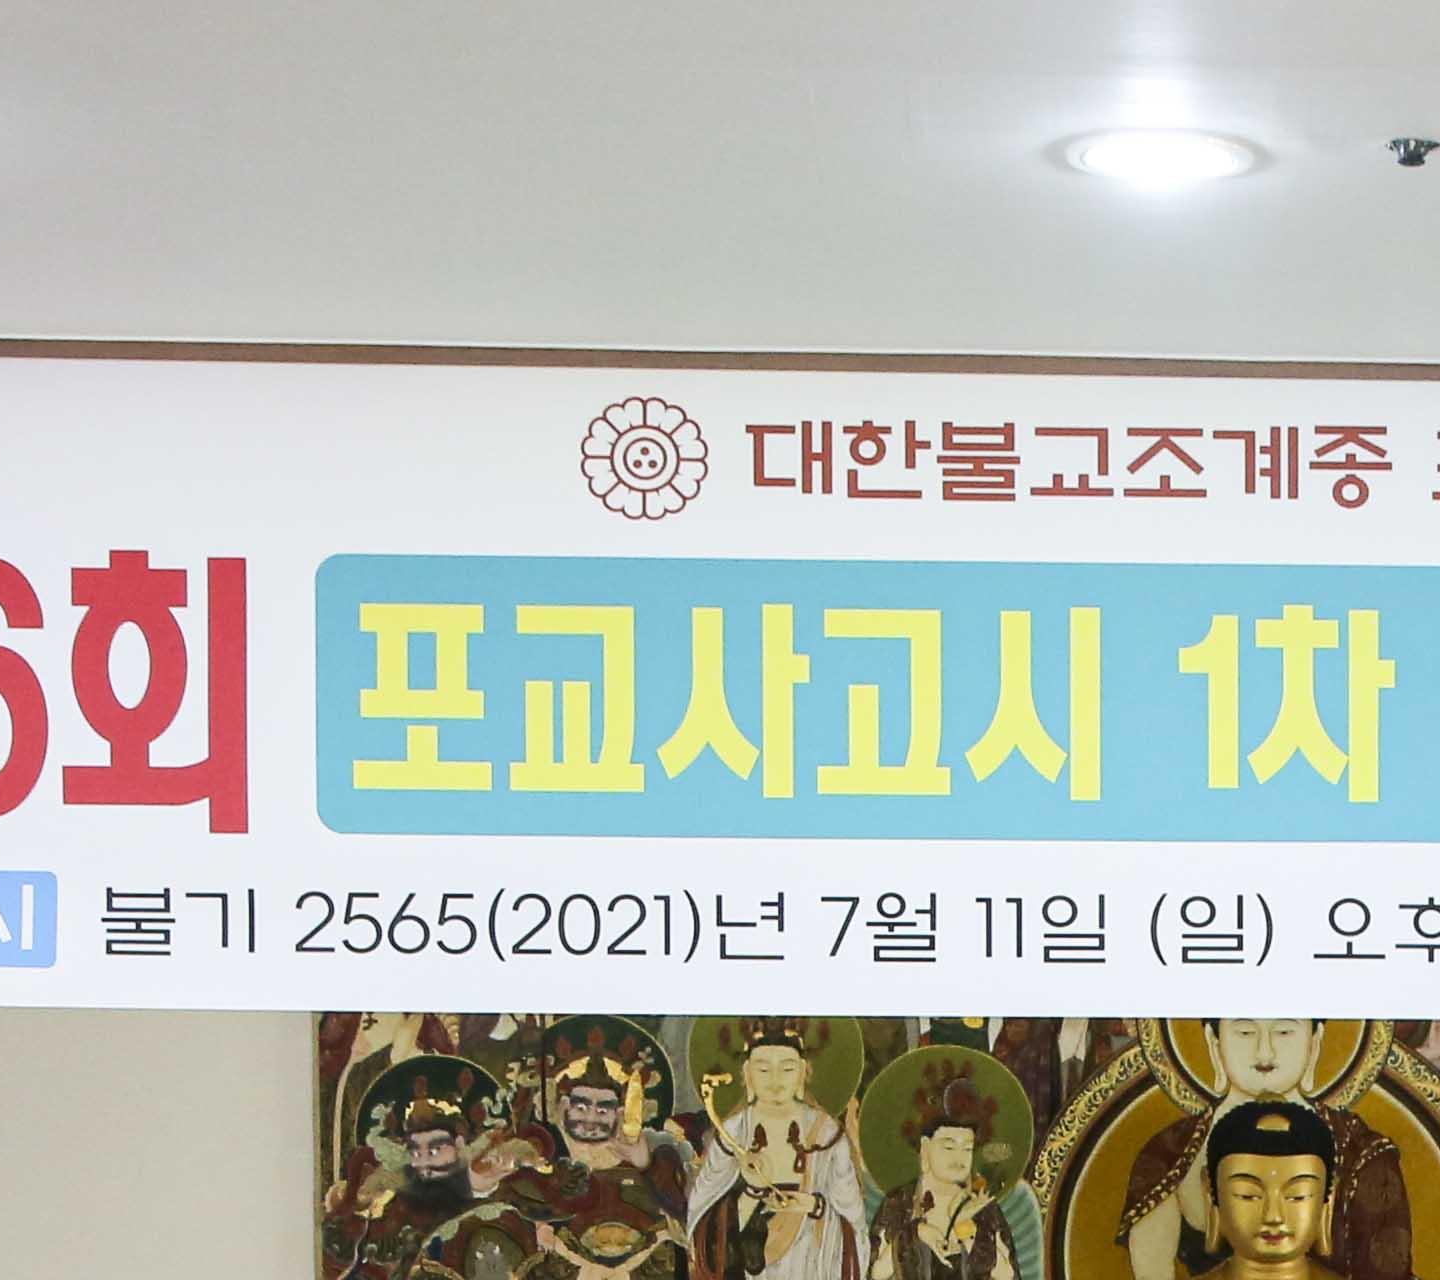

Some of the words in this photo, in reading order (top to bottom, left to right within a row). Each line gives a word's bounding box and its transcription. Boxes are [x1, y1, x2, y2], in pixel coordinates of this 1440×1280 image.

[745, 420, 1392, 509] 대한불교조계종
[354, 604, 1100, 800] 포교사고시
[1180, 605, 1394, 802] 1차
[101, 887, 255, 956] 불기
[296, 888, 784, 963] 2565(2021)년
[821, 892, 936, 962] 7월
[976, 894, 1106, 963] 11일
[1150, 893, 1273, 966] (일)
